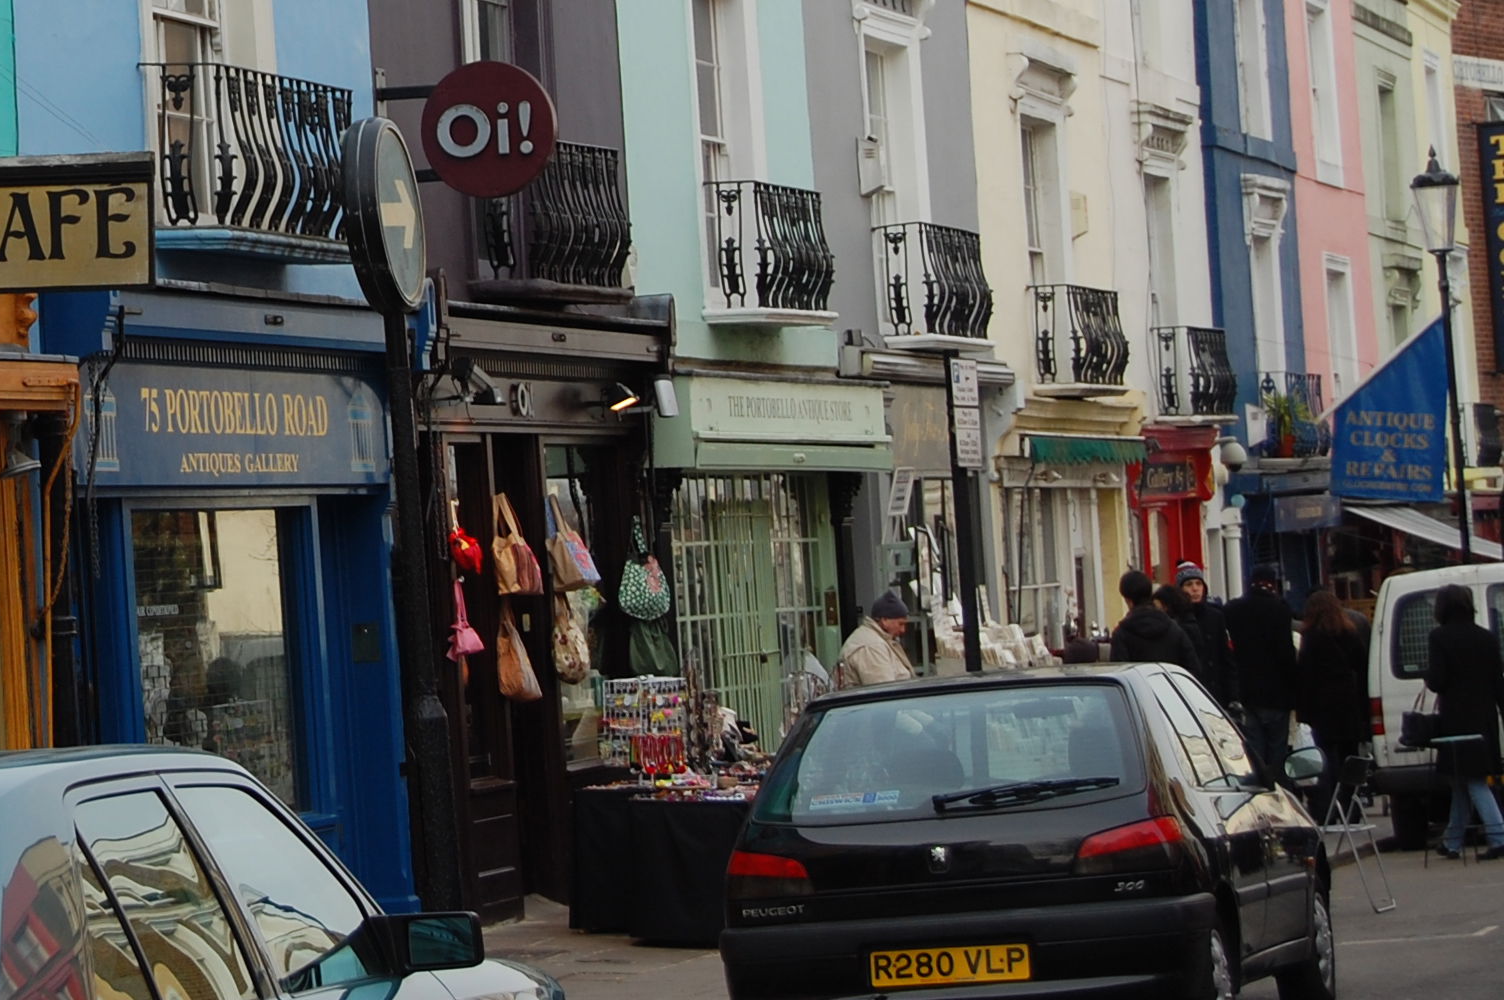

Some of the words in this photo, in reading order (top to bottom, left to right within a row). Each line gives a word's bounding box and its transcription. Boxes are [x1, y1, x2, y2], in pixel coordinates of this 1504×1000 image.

[436, 100, 533, 158] Oi!
[140, 387, 161, 433] 75
[164, 388, 277, 436] PORTOBELLO
[282, 393, 328, 436] ROAD
[728, 395, 745, 418] THE
[746, 396, 796, 420] PORTOBELLO
[1346, 410, 1435, 431] ANTIQUE
[1350, 430, 1430, 450] CLOCKS
[180, 452, 241, 477] ANTIQUES
[245, 453, 300, 473] GALLERY
[1381, 448, 1396, 462] &
[1346, 461, 1433, 480] REPAIRS
[742, 904, 805, 918] PEUGEOT
[873, 951, 955, 980] R280
[964, 946, 1026, 975] VLP
